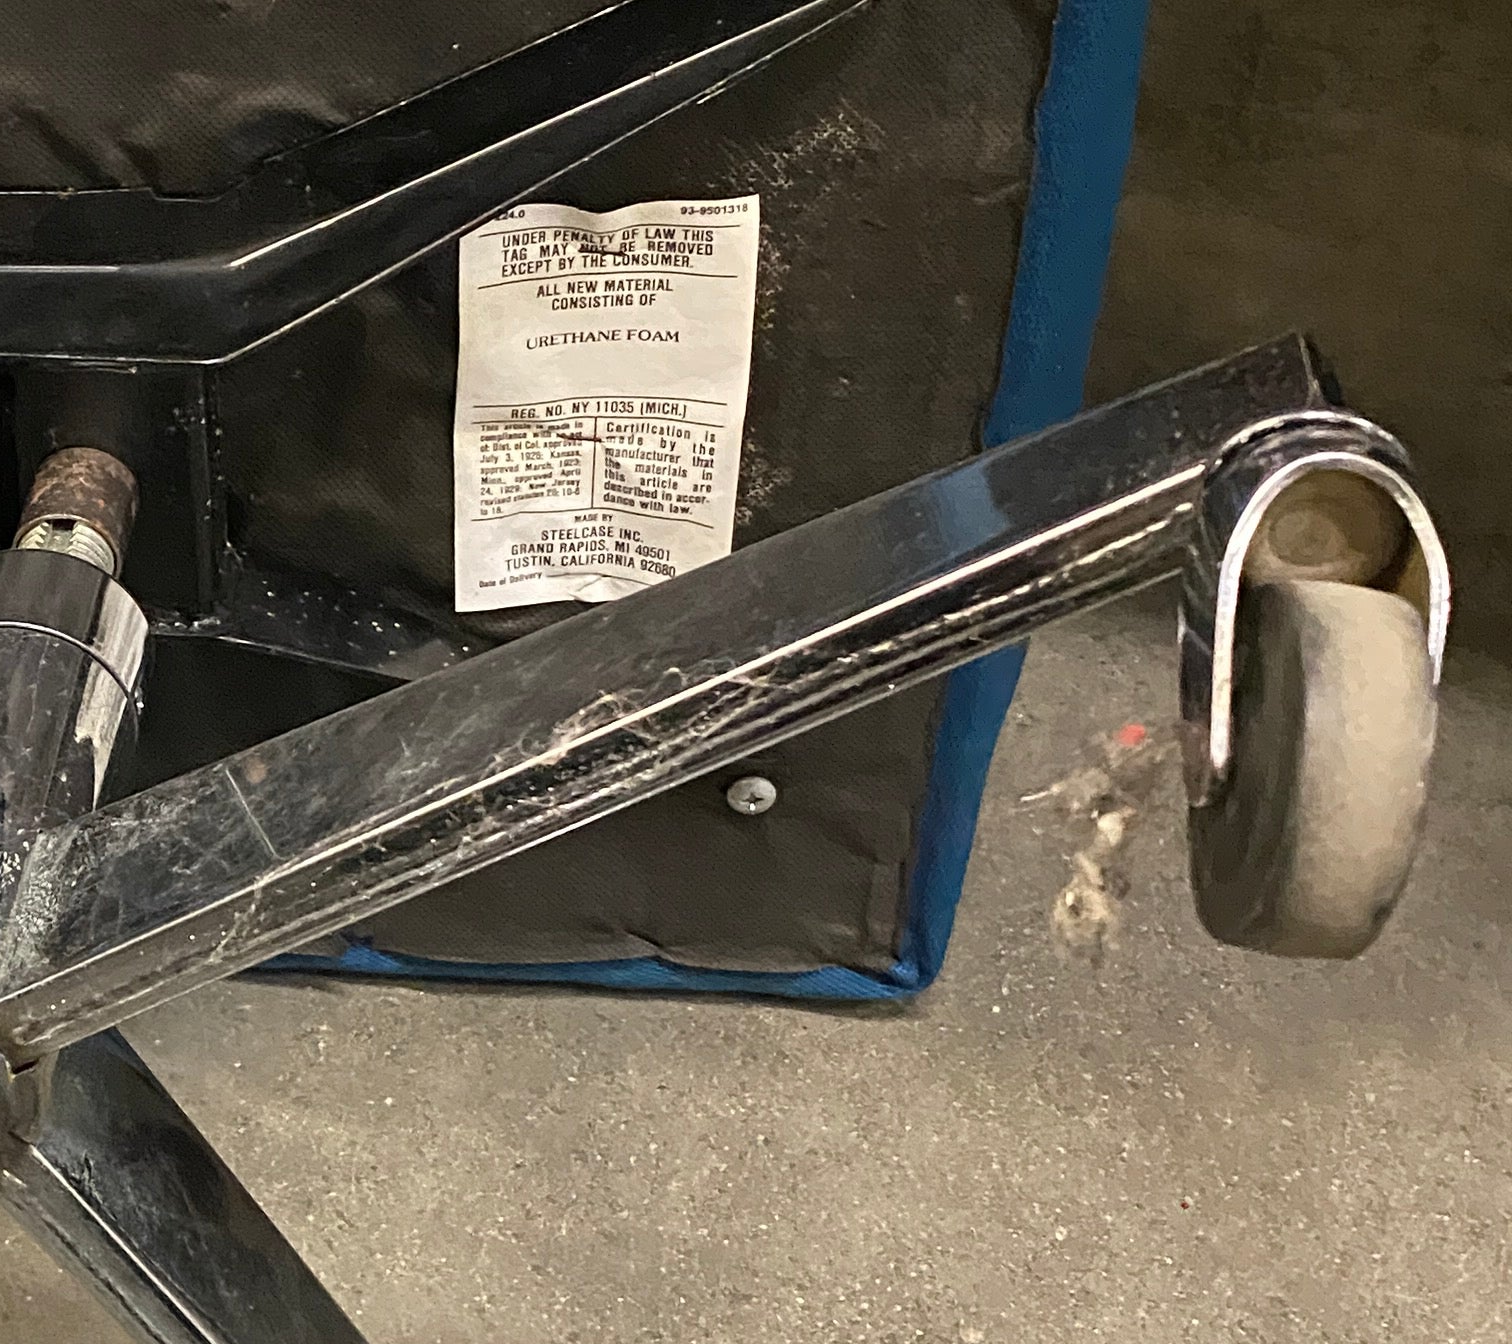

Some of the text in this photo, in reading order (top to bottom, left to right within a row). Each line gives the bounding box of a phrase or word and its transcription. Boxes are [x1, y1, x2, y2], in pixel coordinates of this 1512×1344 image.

[680, 204, 748, 215] 93-9501318
[502, 228, 714, 248] UNDER PENALTY OF LAW THIS
[502, 249, 528, 262] TAG
[540, 243, 568, 258] MAY
[619, 241, 636, 252] BE
[648, 241, 713, 255] REMOVED
[502, 254, 693, 277] EXCEPT BY THE CONSUMER.
[537, 278, 673, 298] ALL NEW MATERIAL
[552, 292, 656, 310] CONSISTING OF
[526, 329, 679, 349] URETHANE FOAM
[511, 402, 687, 419] REG. NO. NY 11035 (MICH.)
[606, 422, 716, 443] Certification is
[660, 437, 676, 451] by
[693, 443, 715, 456] the
[605, 447, 714, 468] manufacturer that
[605, 457, 712, 481] the materials in
[604, 469, 712, 493] this article are
[603, 492, 693, 515] dance with law.
[604, 482, 710, 505] described in accor-
[575, 514, 614, 523] MADE BY
[541, 526, 644, 543] STEELCASE INC.
[511, 544, 554, 556] GRAND
[615, 540, 630, 552] MI
[635, 544, 670, 562] 49501
[506, 554, 676, 578] TUSTIN, CALIFORNIA 92680
[478, 572, 542, 588] Date of Delivery
